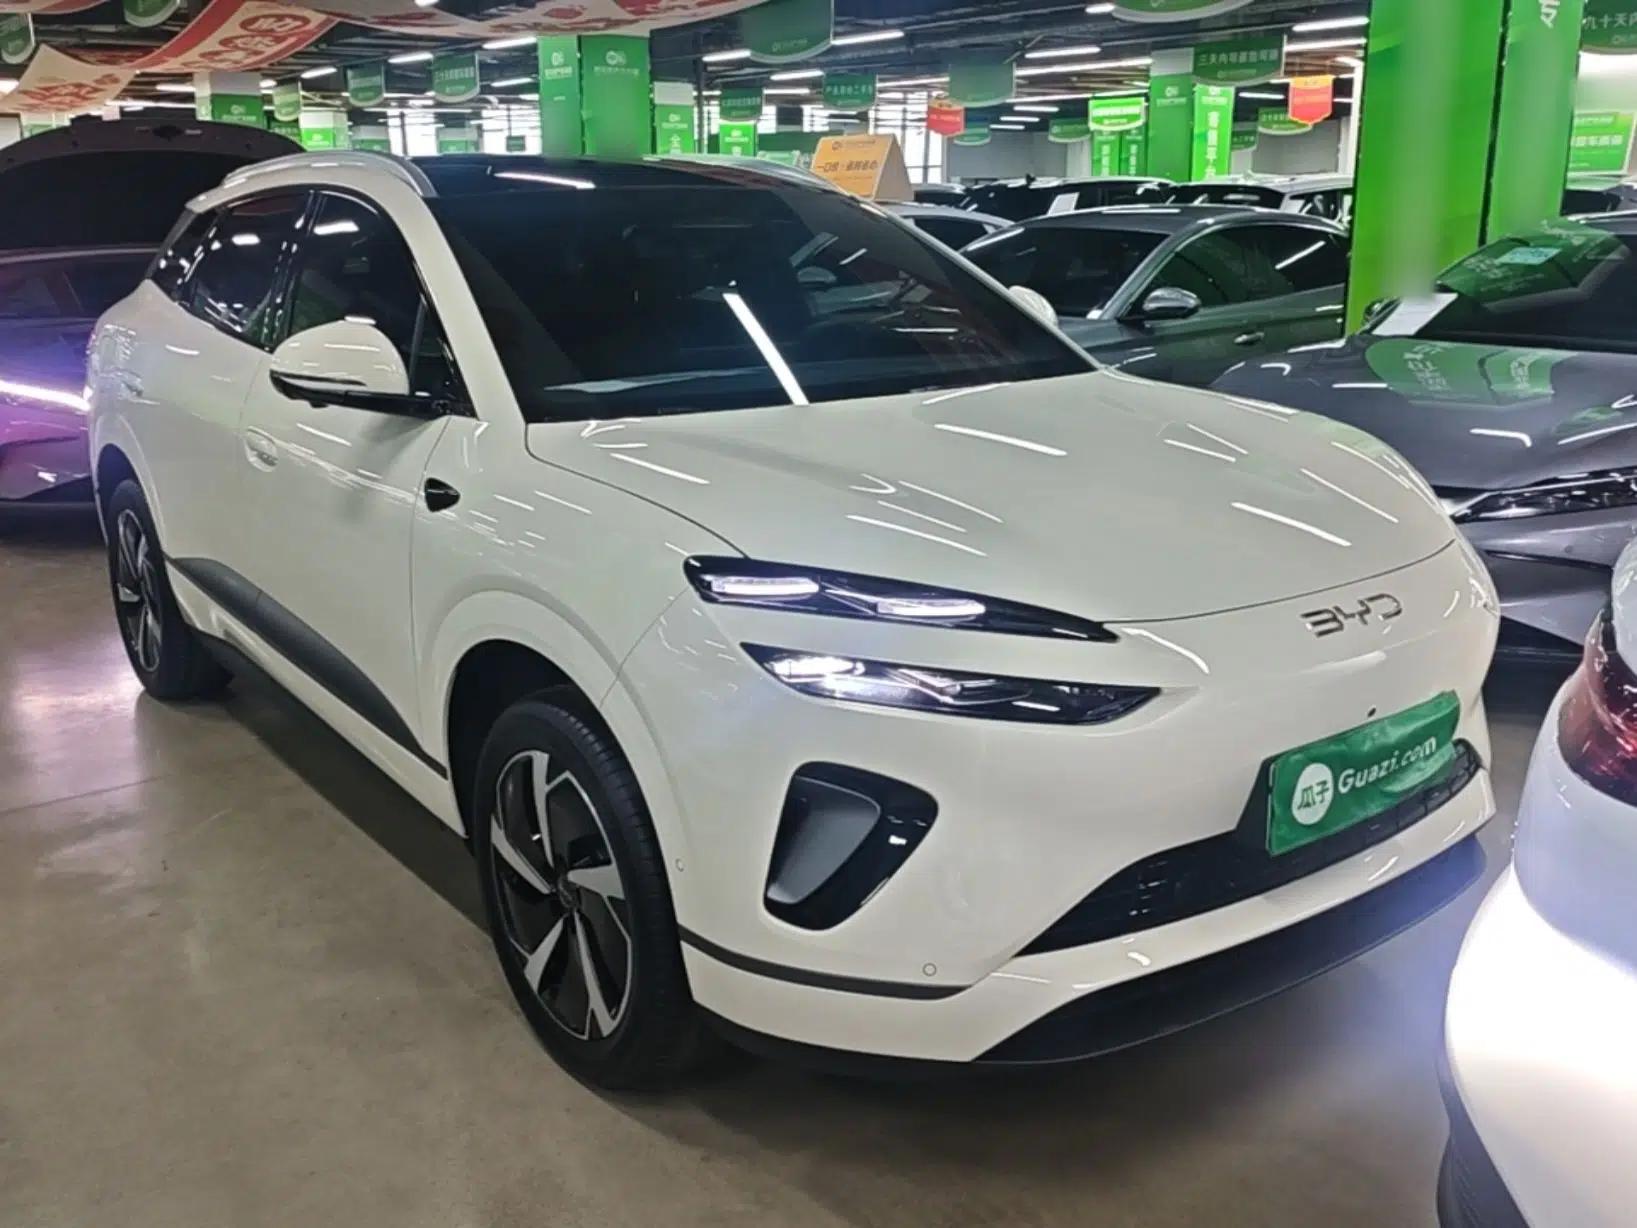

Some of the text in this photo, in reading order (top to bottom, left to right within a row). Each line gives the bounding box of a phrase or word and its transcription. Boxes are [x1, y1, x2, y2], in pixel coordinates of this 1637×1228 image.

[1300, 593, 1403, 637] BYD
[1338, 736, 1437, 794] Guazi.com
[1297, 777, 1330, 811] 瓜子
